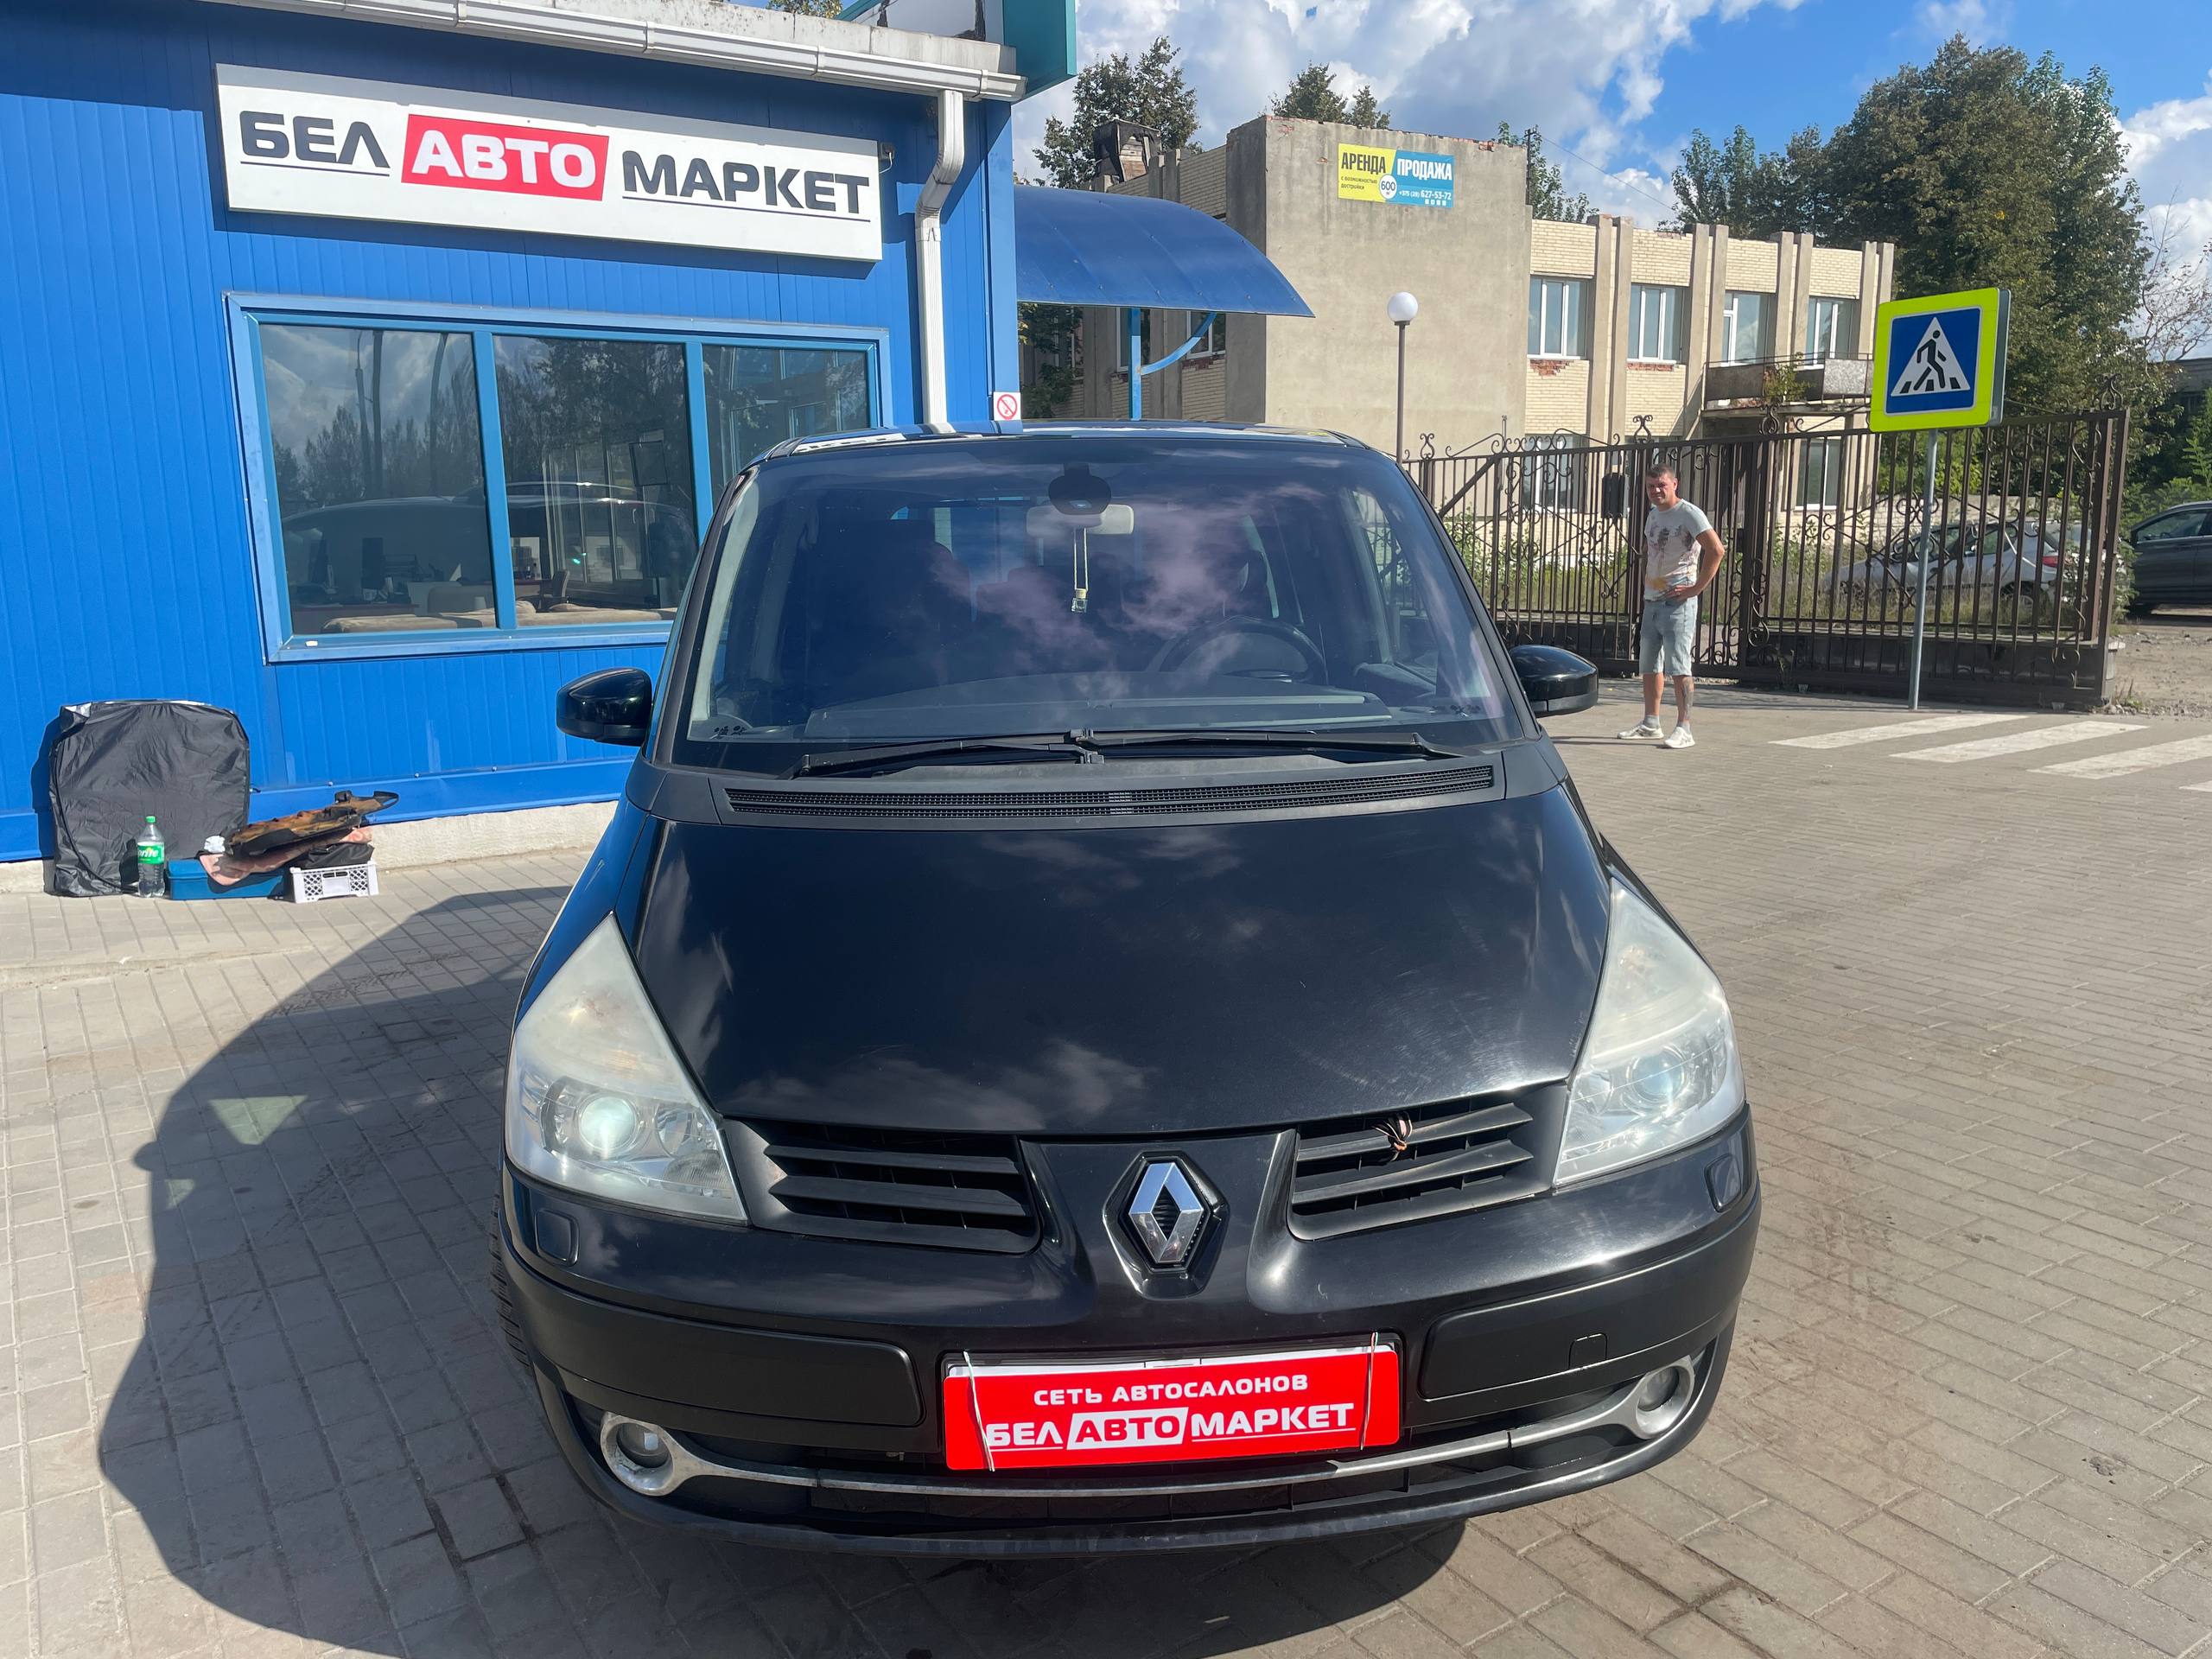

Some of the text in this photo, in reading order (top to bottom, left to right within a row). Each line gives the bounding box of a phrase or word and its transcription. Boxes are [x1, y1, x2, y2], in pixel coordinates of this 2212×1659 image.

[239, 110, 870, 214] БЕЛ АВТО МАРКЕТ
[1341, 151, 1386, 175] АРЕНДА
[1397, 158, 1452, 181] ПРОДАЖА
[1381, 180, 1396, 191] 600
[1421, 189, 1452, 200] 627-53-72
[1033, 1374, 1308, 1406] СЕТЬ АВТОСАЛОНОВ
[986, 1402, 1354, 1446] БЕЛ АВТО МАРКЕТ
